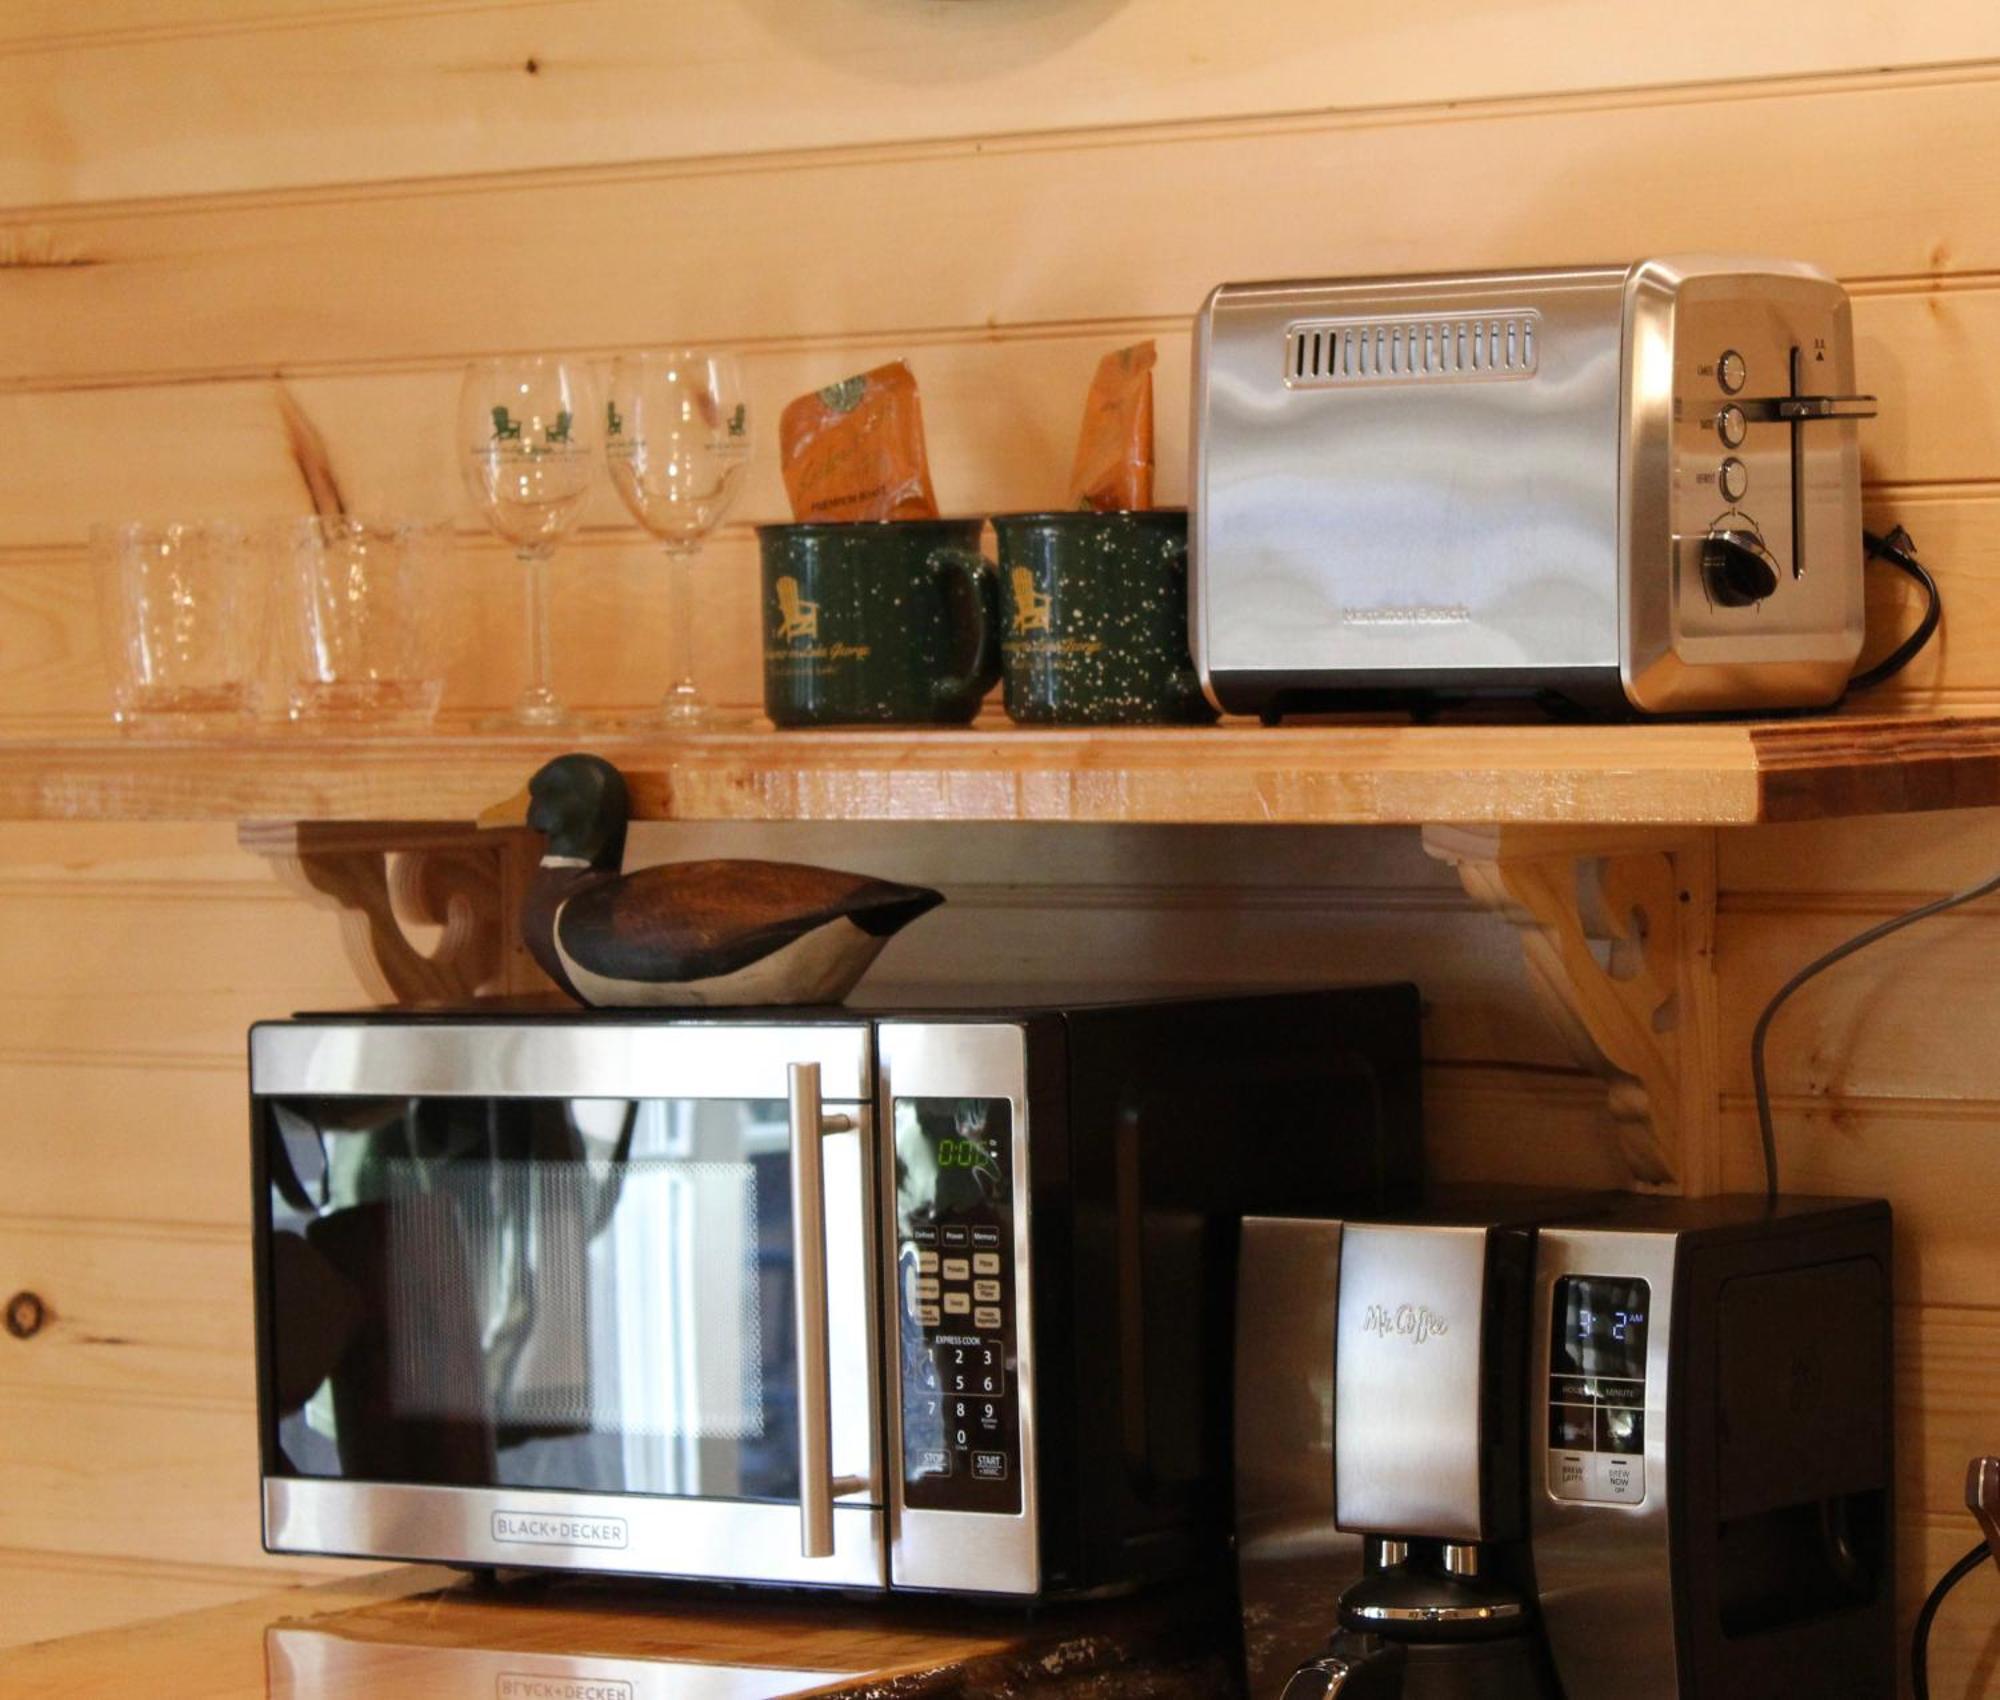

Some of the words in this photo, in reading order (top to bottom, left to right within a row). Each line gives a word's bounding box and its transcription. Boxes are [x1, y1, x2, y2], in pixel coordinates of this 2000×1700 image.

[1396, 1303, 1449, 1345] Coffee
[1629, 1313, 1644, 1323] AM
[935, 1334, 962, 1345] EXPRESS
[962, 1335, 981, 1346] COOK
[928, 1349, 934, 1362] 1
[955, 1350, 963, 1364] 2
[983, 1351, 992, 1365] 3
[956, 1376, 964, 1390] 5
[983, 1377, 993, 1391] 6
[927, 1402, 935, 1415] 7
[956, 1403, 965, 1417] 8
[984, 1404, 993, 1418] 9
[957, 1430, 966, 1444] 0
[978, 1455, 1001, 1466] START
[1609, 1469, 1630, 1479] BREW
[1610, 1478, 1629, 1487] NOW
[498, 1519, 621, 1540] BLACK+DECKER
